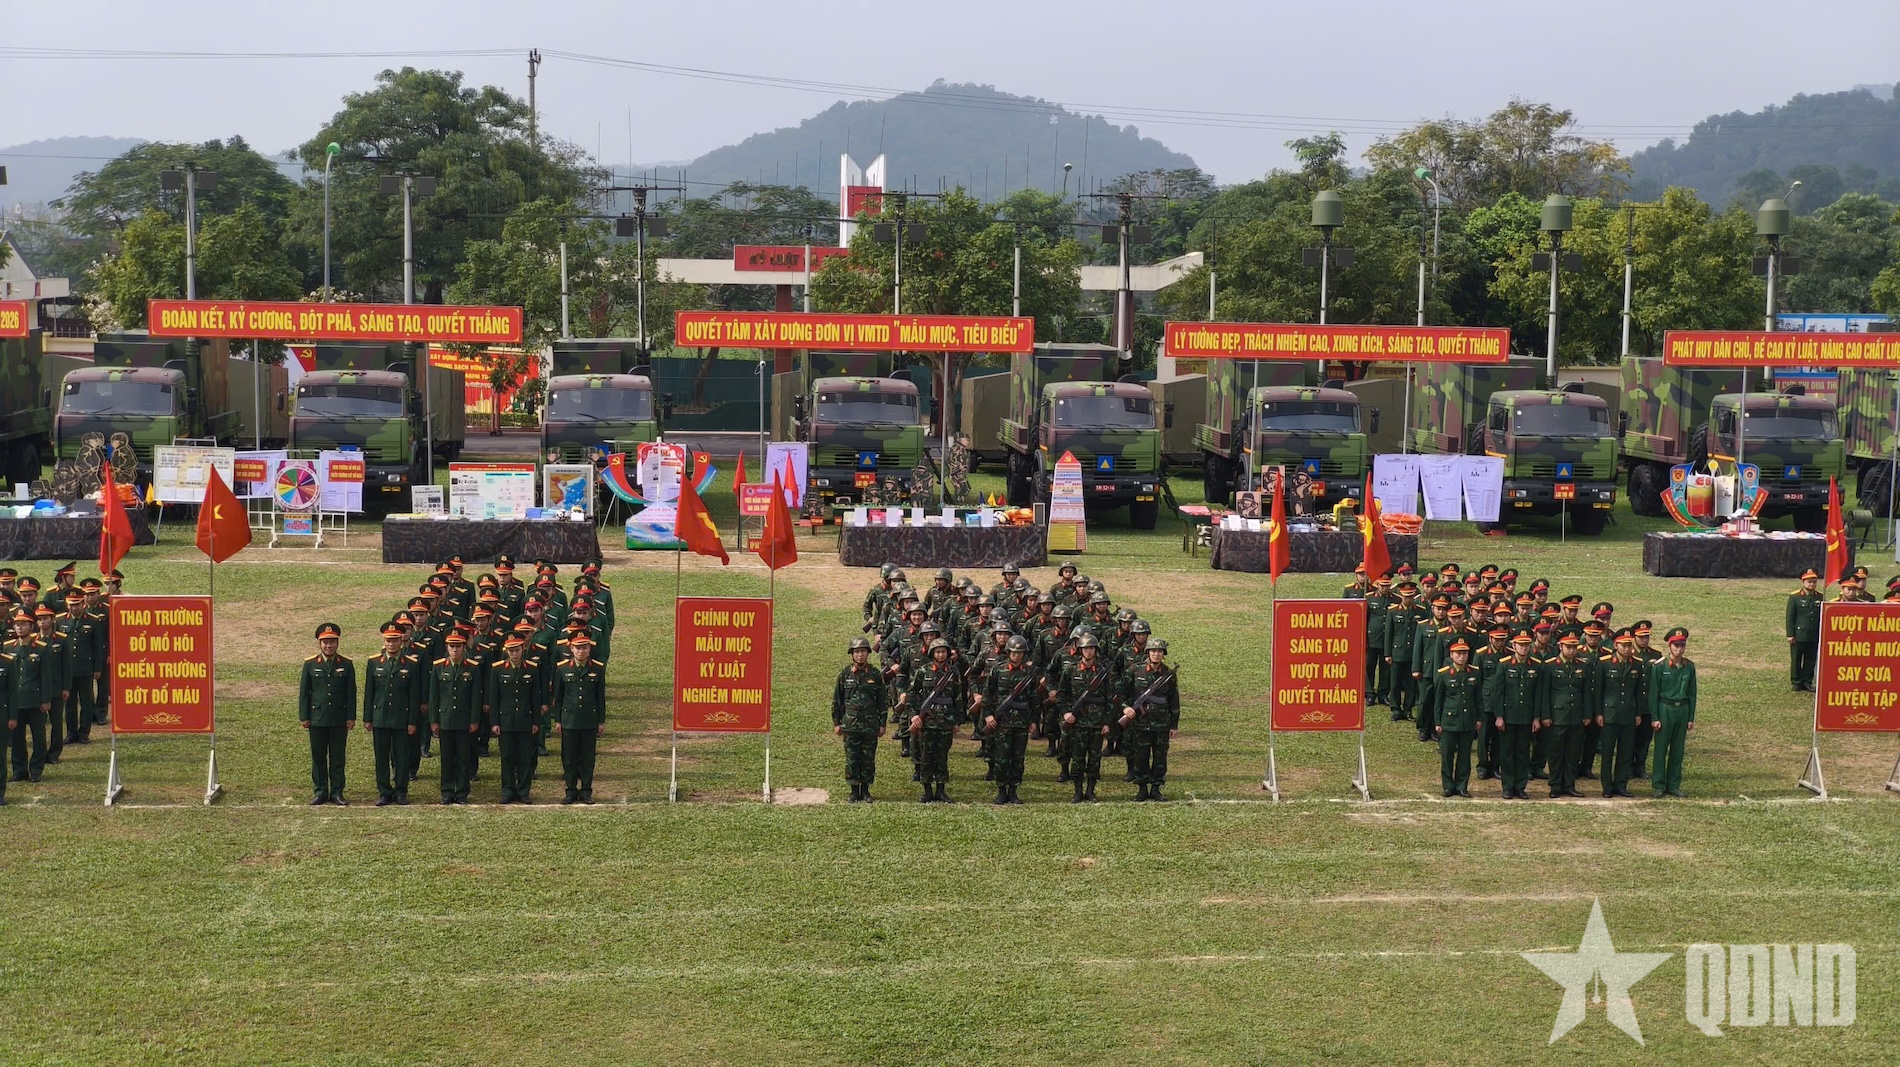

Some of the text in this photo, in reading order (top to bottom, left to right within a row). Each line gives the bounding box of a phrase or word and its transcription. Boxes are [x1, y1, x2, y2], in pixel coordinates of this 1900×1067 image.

[1, 311, 19, 329] 2026
[162, 305, 510, 337] ĐOÀN KẾT, KỶ CƯƠNG, ĐỘT PHÁ, SÁNG TẠO, QUYẾT THẮNG
[685, 316, 722, 341] QUYẾT
[725, 318, 751, 341] TÂM
[754, 319, 777, 341] XÂY
[780, 321, 812, 345] DỰNG
[815, 322, 840, 342] ĐƠN
[843, 323, 855, 346] VỊ
[857, 324, 890, 343] VMTD
[930, 324, 959, 348] MỰC,
[963, 322, 988, 345] TIÊU
[1175, 326, 1500, 357] LÝ TƯỞNG ĐẸP, TRÁCH NHIỆM CAO, XUNG KÍCH, SÁNG TẠO, QUYẾT THẮNG
[1672, 337, 1694, 358] PHÁT
[1695, 341, 1712, 358] HUY
[1713, 338, 1731, 359] DÂN
[1733, 335, 1752, 360] CHỦ,
[1767, 341, 1783, 359] CAO
[1785, 336, 1796, 359] KỶ
[1797, 338, 1819, 363] LUẬT,
[1820, 338, 1844, 360] NÂNG
[1846, 342, 1862, 360] CAO
[1864, 336, 1885, 360] CHẤT
[120, 606, 203, 626] THAO TRƯỜNG
[693, 608, 755, 628] CHÍNH QUY
[1290, 609, 1349, 629] ĐOÀN KẾT
[1830, 614, 1864, 635] VƯỢT
[129, 630, 194, 652] ĐỔ MỒ HÔI
[695, 631, 752, 656] MẪU MỰC
[1290, 636, 1349, 657] SÁNG TẠO
[1827, 636, 1871, 656] THẮNG
[118, 657, 207, 678] CHIẾN TRƯỜNG
[699, 657, 746, 681] KỶ LUẬT
[1290, 661, 1347, 682] VƯỢT KHÓ
[1837, 665, 1892, 682] SAY SƯA
[125, 683, 200, 704] BỚT ĐỔ MÁU
[682, 685, 763, 704] NGHIÊM MINH
[1278, 684, 1358, 705] QUYẾT THẮNG
[1827, 688, 1898, 710] LUYỆN TẬP
